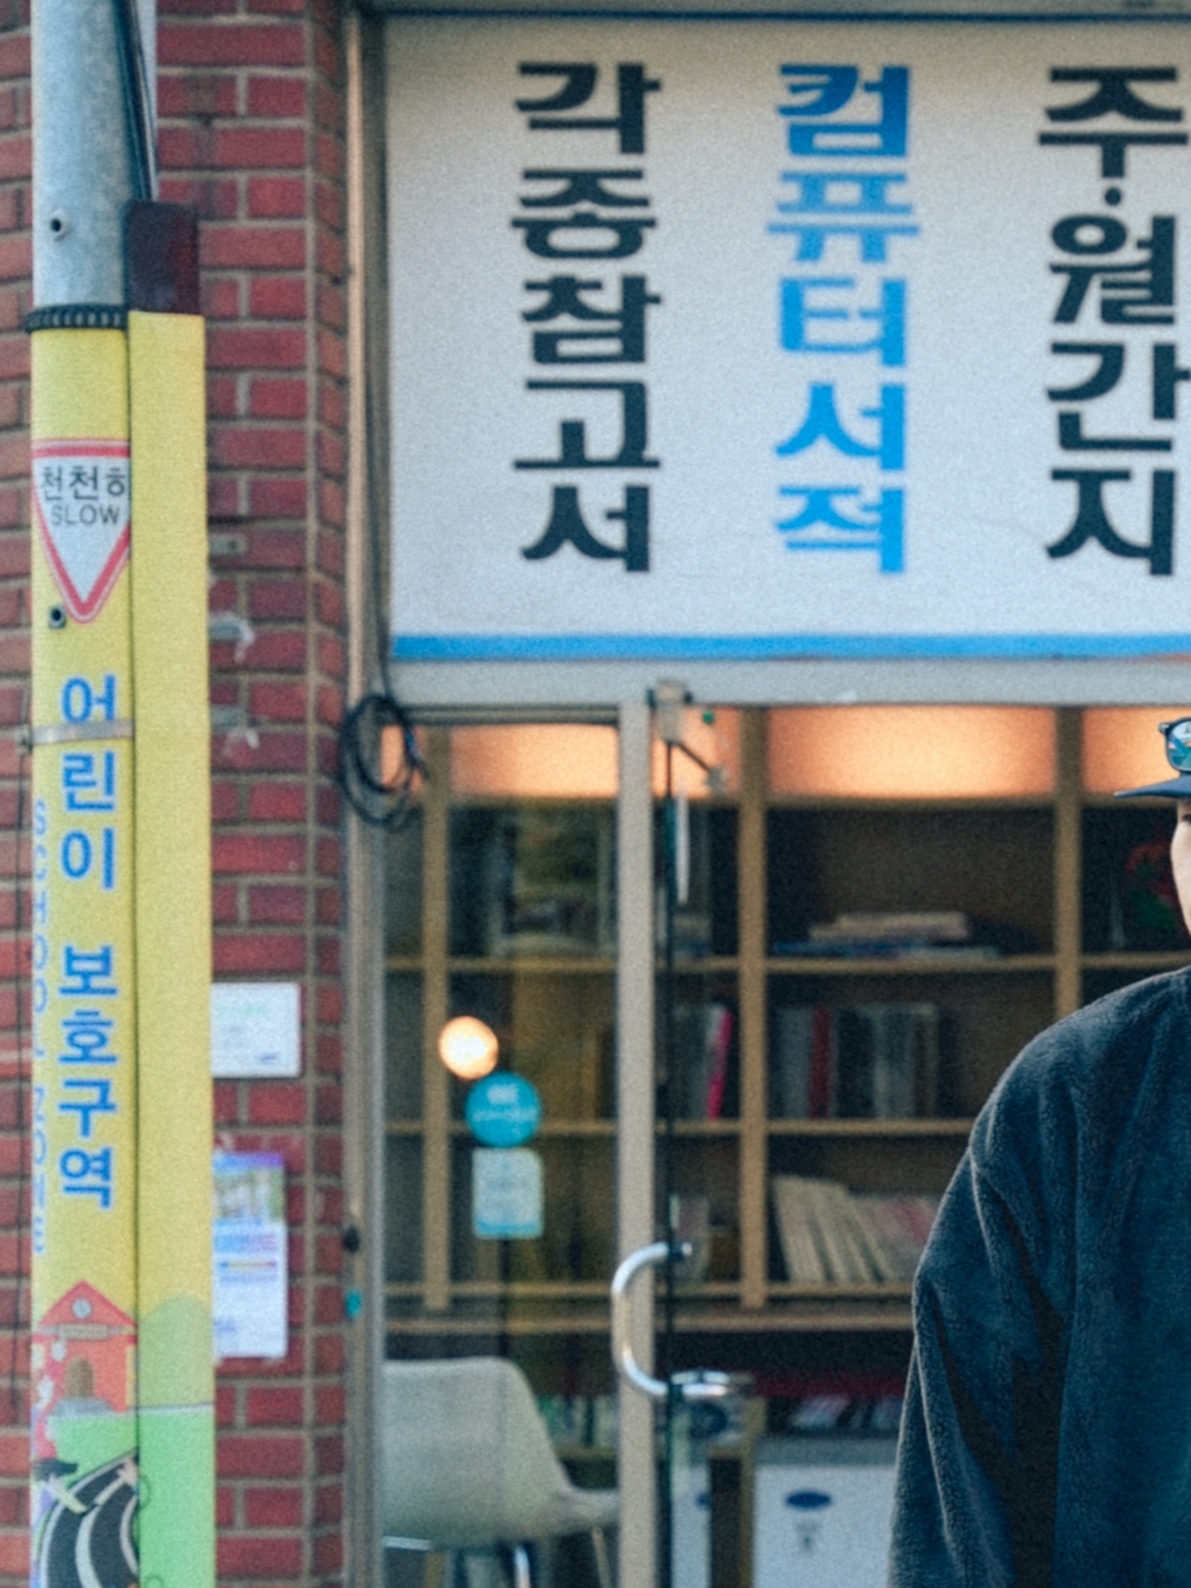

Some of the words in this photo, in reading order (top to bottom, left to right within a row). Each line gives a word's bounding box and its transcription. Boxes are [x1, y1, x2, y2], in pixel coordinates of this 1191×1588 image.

[510, 62, 662, 573] 각종참고서
[767, 64, 921, 574] 컴퓨터서적
[50, 503, 120, 527] SLOW
[60, 673, 117, 890] 어린이
[57, 944, 119, 1209] 보호구역
